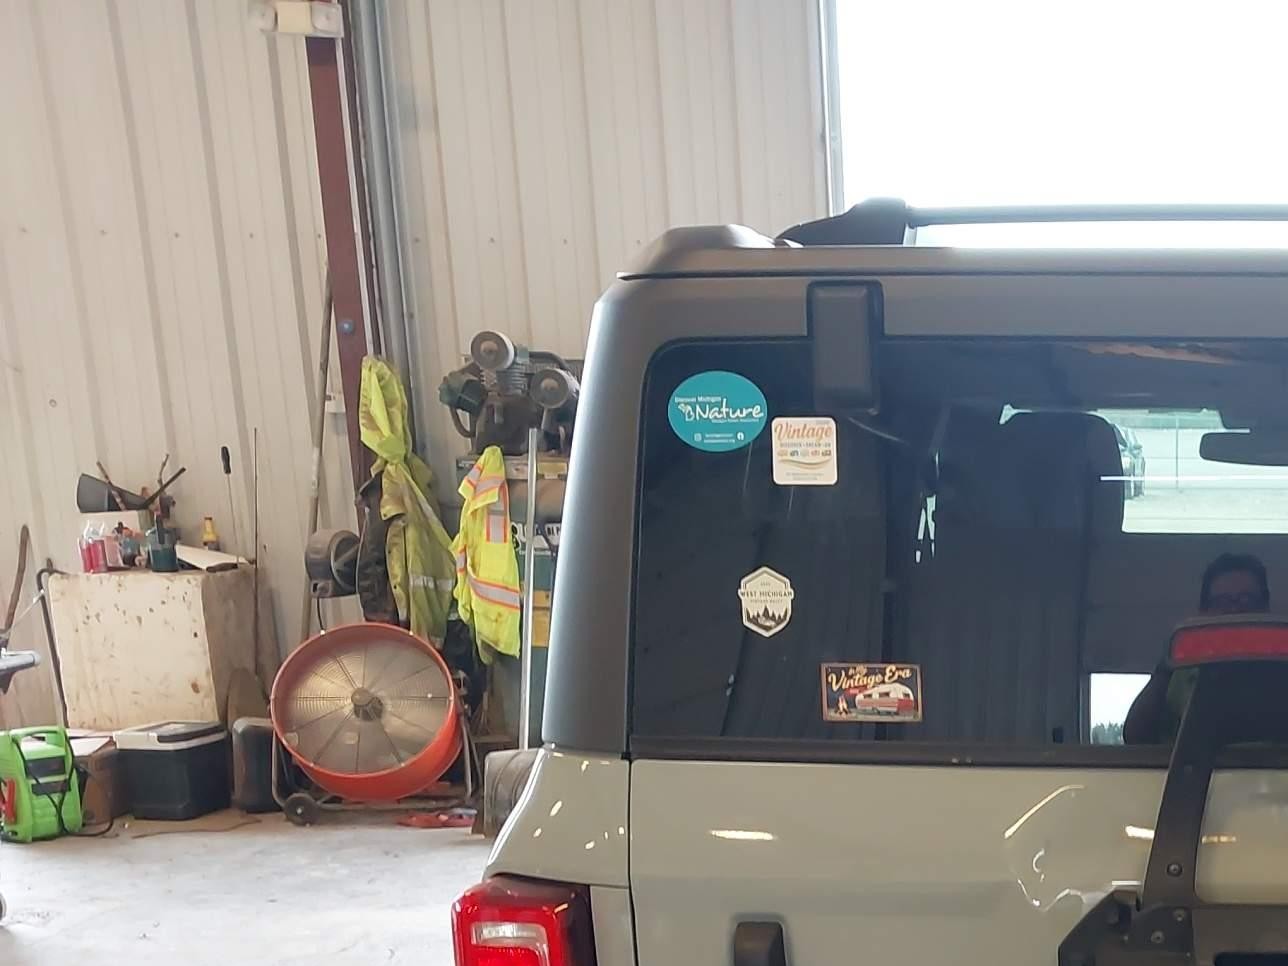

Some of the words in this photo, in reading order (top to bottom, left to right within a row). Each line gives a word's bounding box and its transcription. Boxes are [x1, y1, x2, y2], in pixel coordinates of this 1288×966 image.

[696, 398, 764, 420] Nature
[774, 422, 833, 442] Vintage
[828, 669, 884, 692] Vintage
[884, 664, 912, 684] Era
